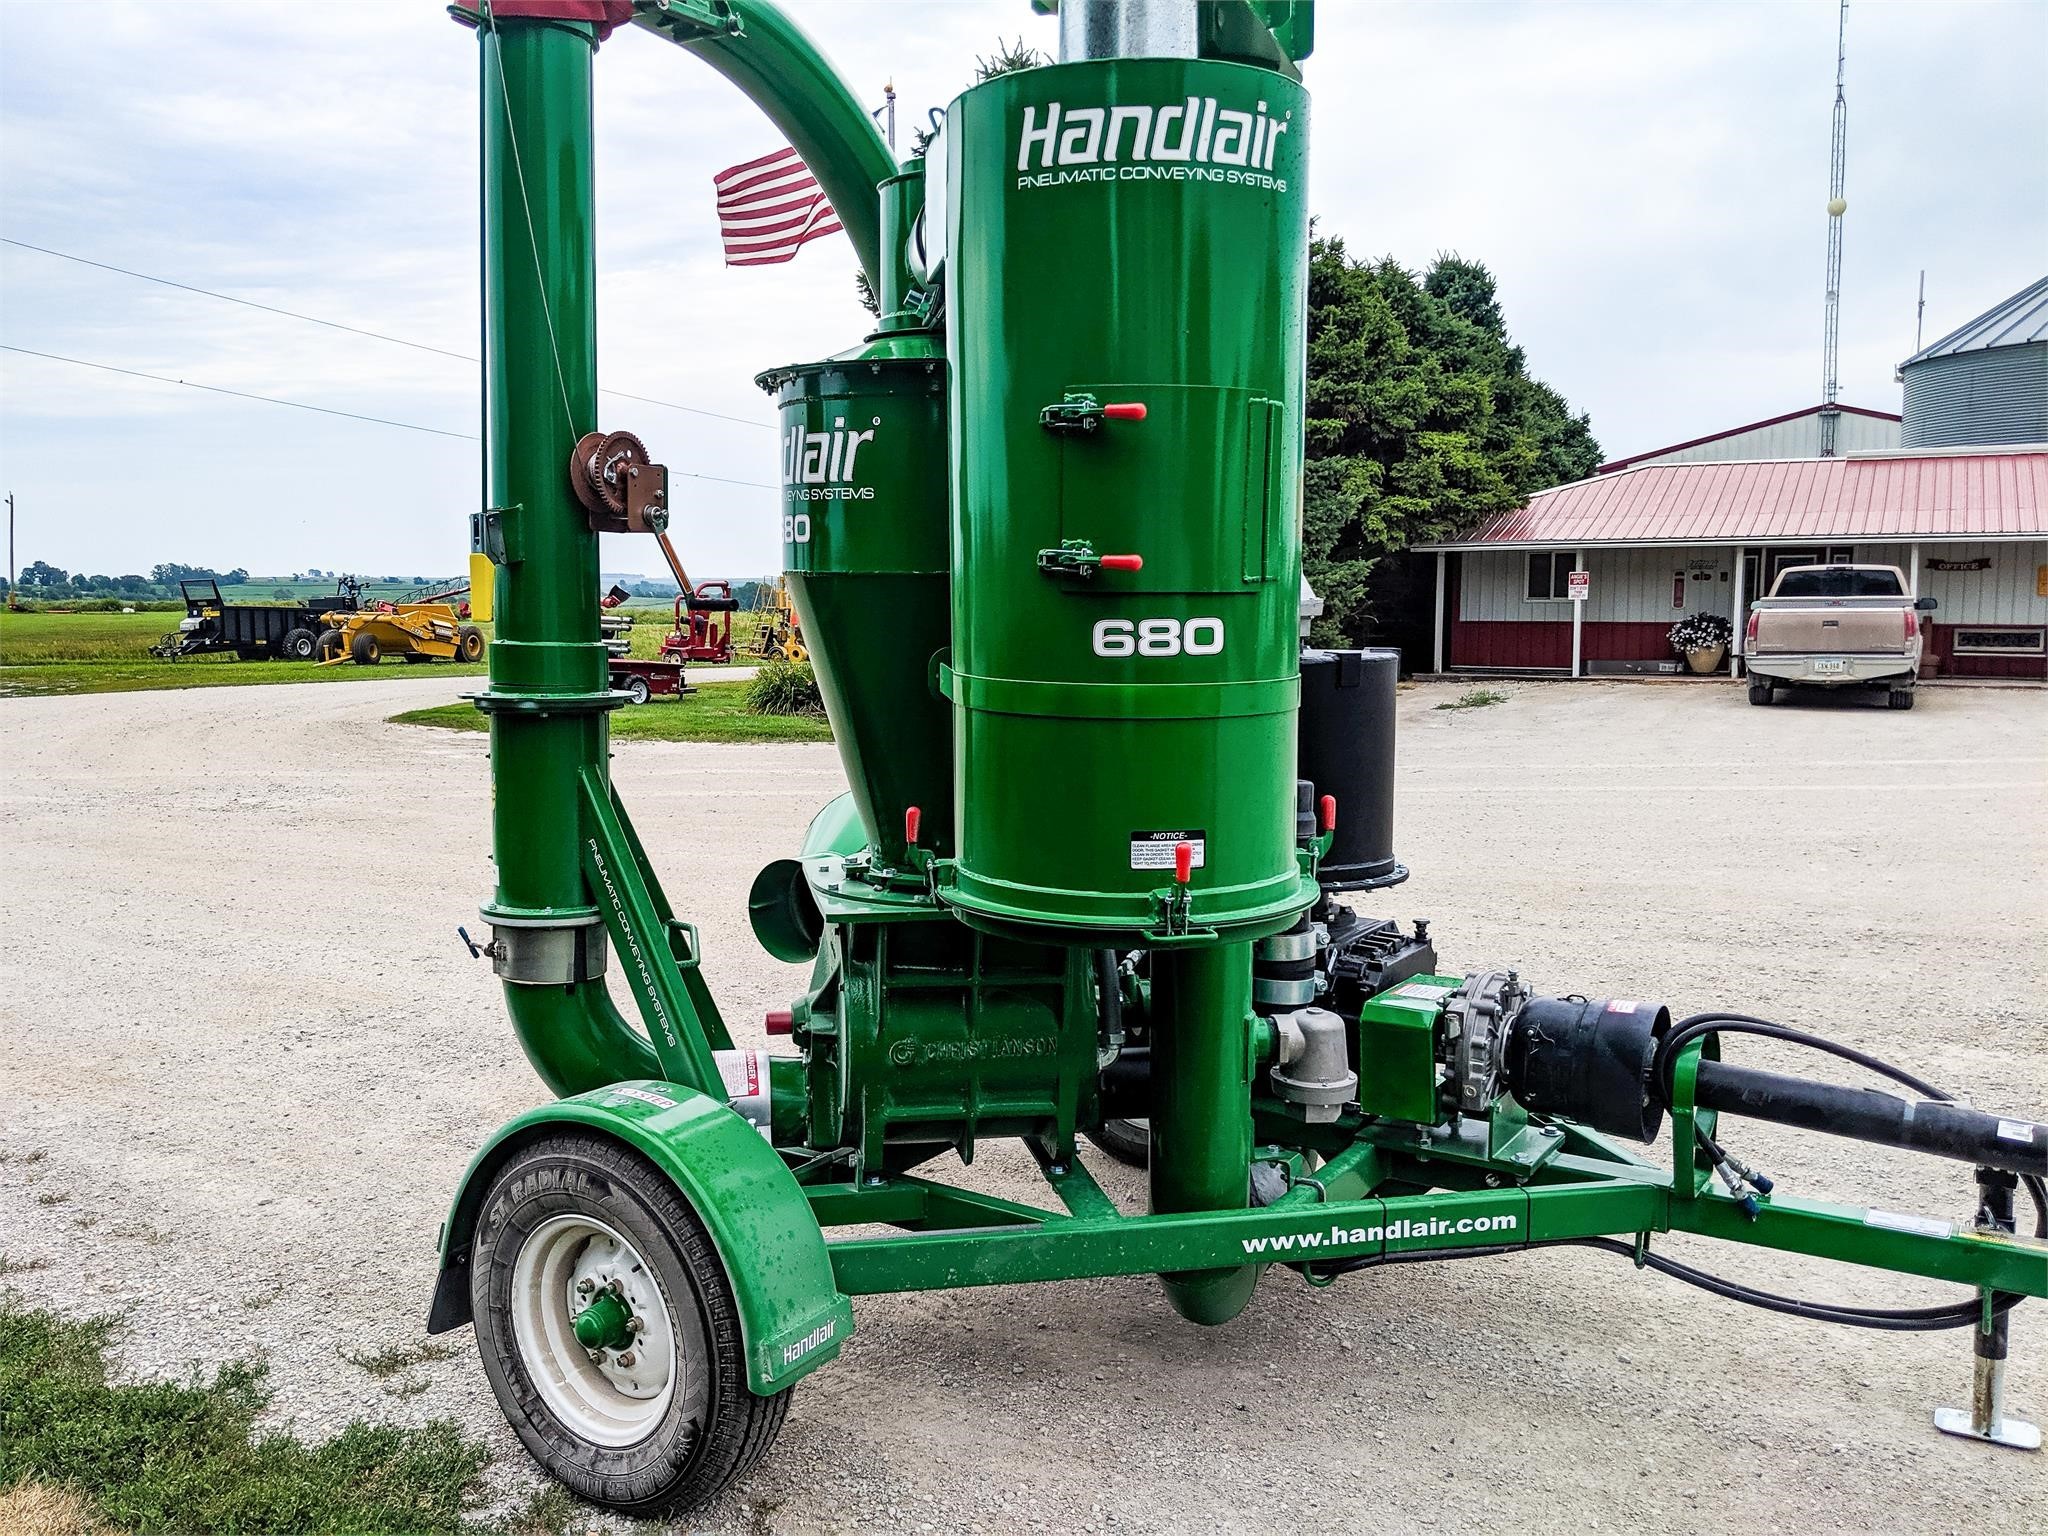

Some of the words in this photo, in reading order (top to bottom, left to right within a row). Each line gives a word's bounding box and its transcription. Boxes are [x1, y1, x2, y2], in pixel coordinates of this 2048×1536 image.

[1017, 96, 1288, 172] Handlair
[1017, 166, 1115, 190] PNEUMATIC
[1119, 165, 1224, 182] CONVEYING
[1226, 171, 1287, 193] SYSTEMS
[811, 487, 875, 500] SYSTEMS
[783, 513, 811, 544] 80
[1939, 562, 1979, 570] OFFICE
[1093, 617, 1224, 657] 680
[588, 838, 621, 911] PNEUMATIC
[617, 910, 651, 985] CONVEYING
[647, 985, 676, 1048] SYSTEMS
[746, 1052, 756, 1080] DANGER
[510, 1168, 590, 1205] RADIAL
[1242, 1214, 1517, 1253] www.handlair.com
[783, 1319, 837, 1366] Handlair
